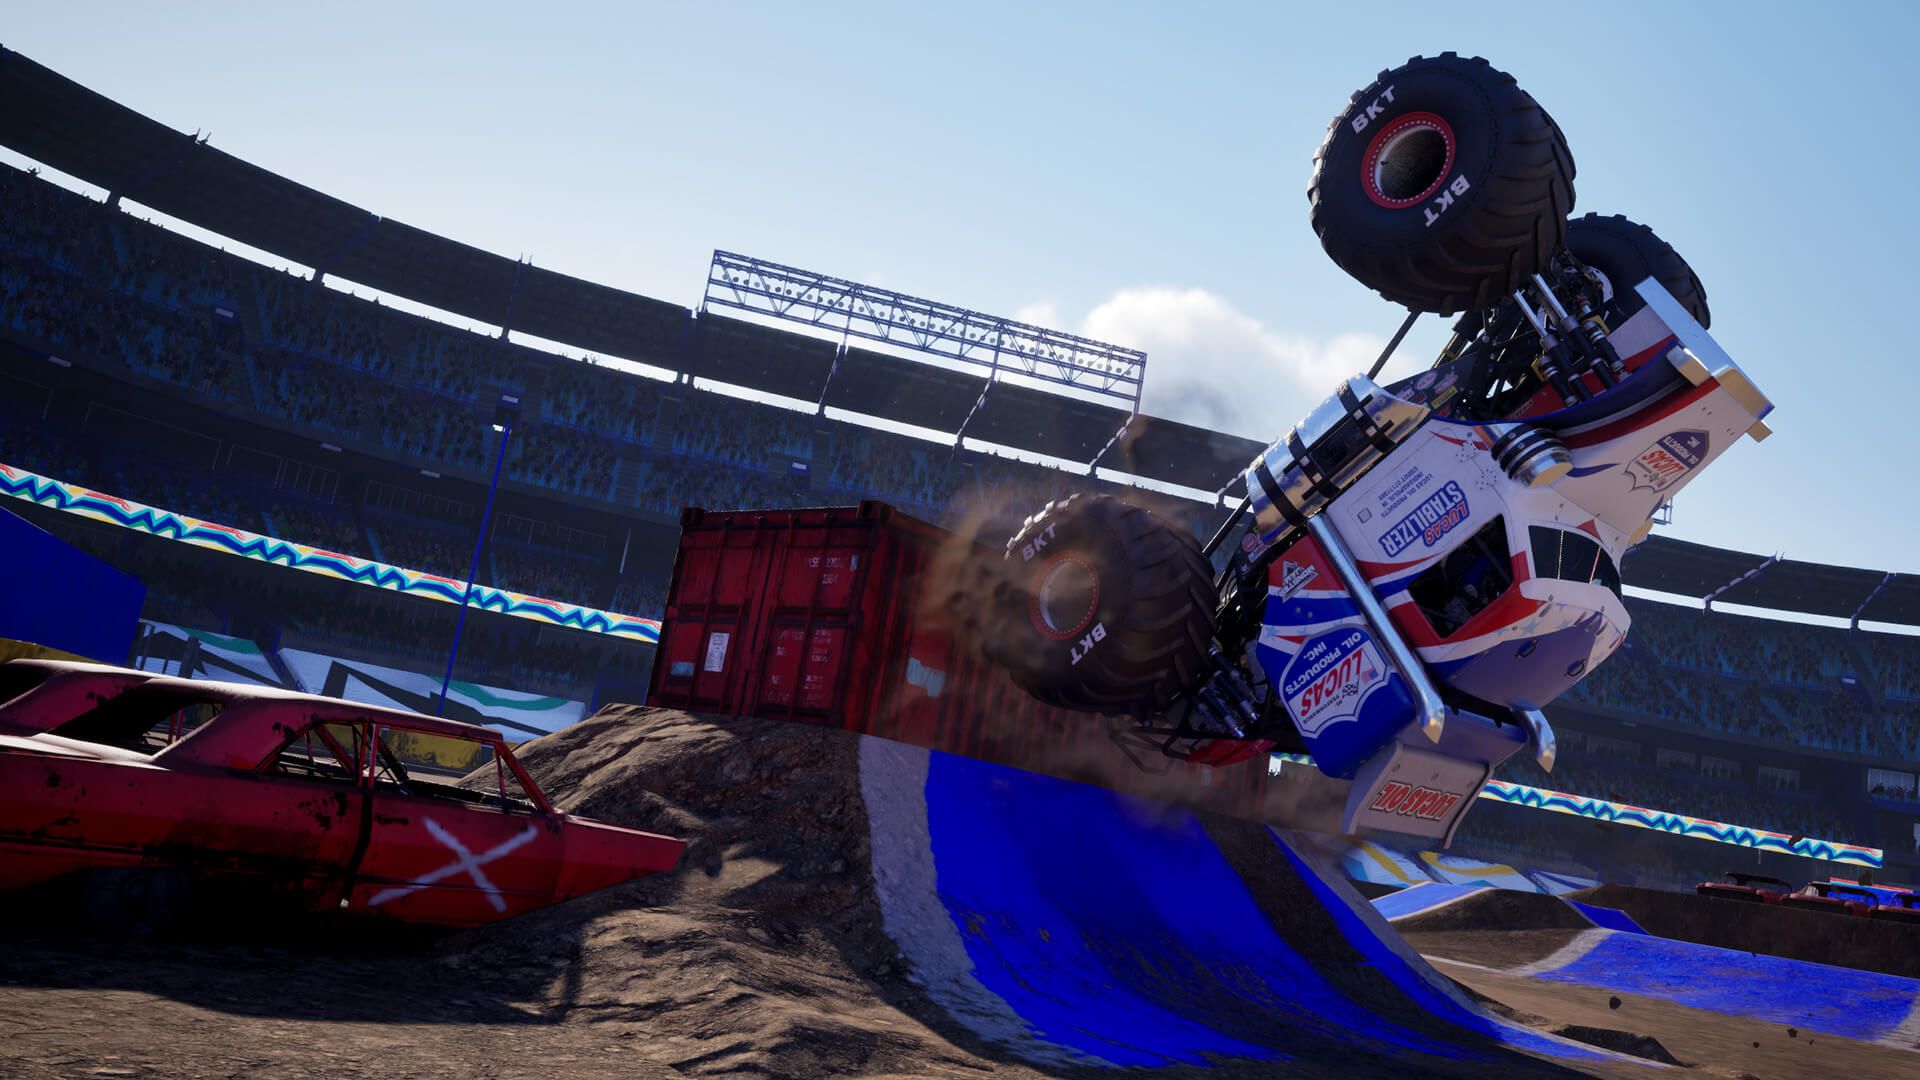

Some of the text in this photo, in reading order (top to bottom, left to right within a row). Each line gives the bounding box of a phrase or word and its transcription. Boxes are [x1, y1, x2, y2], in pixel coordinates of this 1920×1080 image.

[1351, 85, 1395, 134] BKT
[1423, 174, 1471, 227] BKT
[1641, 449, 1685, 477] LUCAS
[1662, 435, 1692, 459] PRODUCTS
[1379, 472, 1433, 518] LUCAS OIL PRODUCTS
[1381, 482, 1464, 556] STABILIZER
[1425, 500, 1469, 545] LUCAS
[1022, 522, 1057, 562] BKT
[1069, 622, 1107, 666] BKT
[1285, 631, 1362, 695] OIL PRODUCTS
[1303, 640, 1327, 660] INC.
[1301, 648, 1364, 717] LUCAS
[1373, 782, 1458, 818] LUCAS OIL
